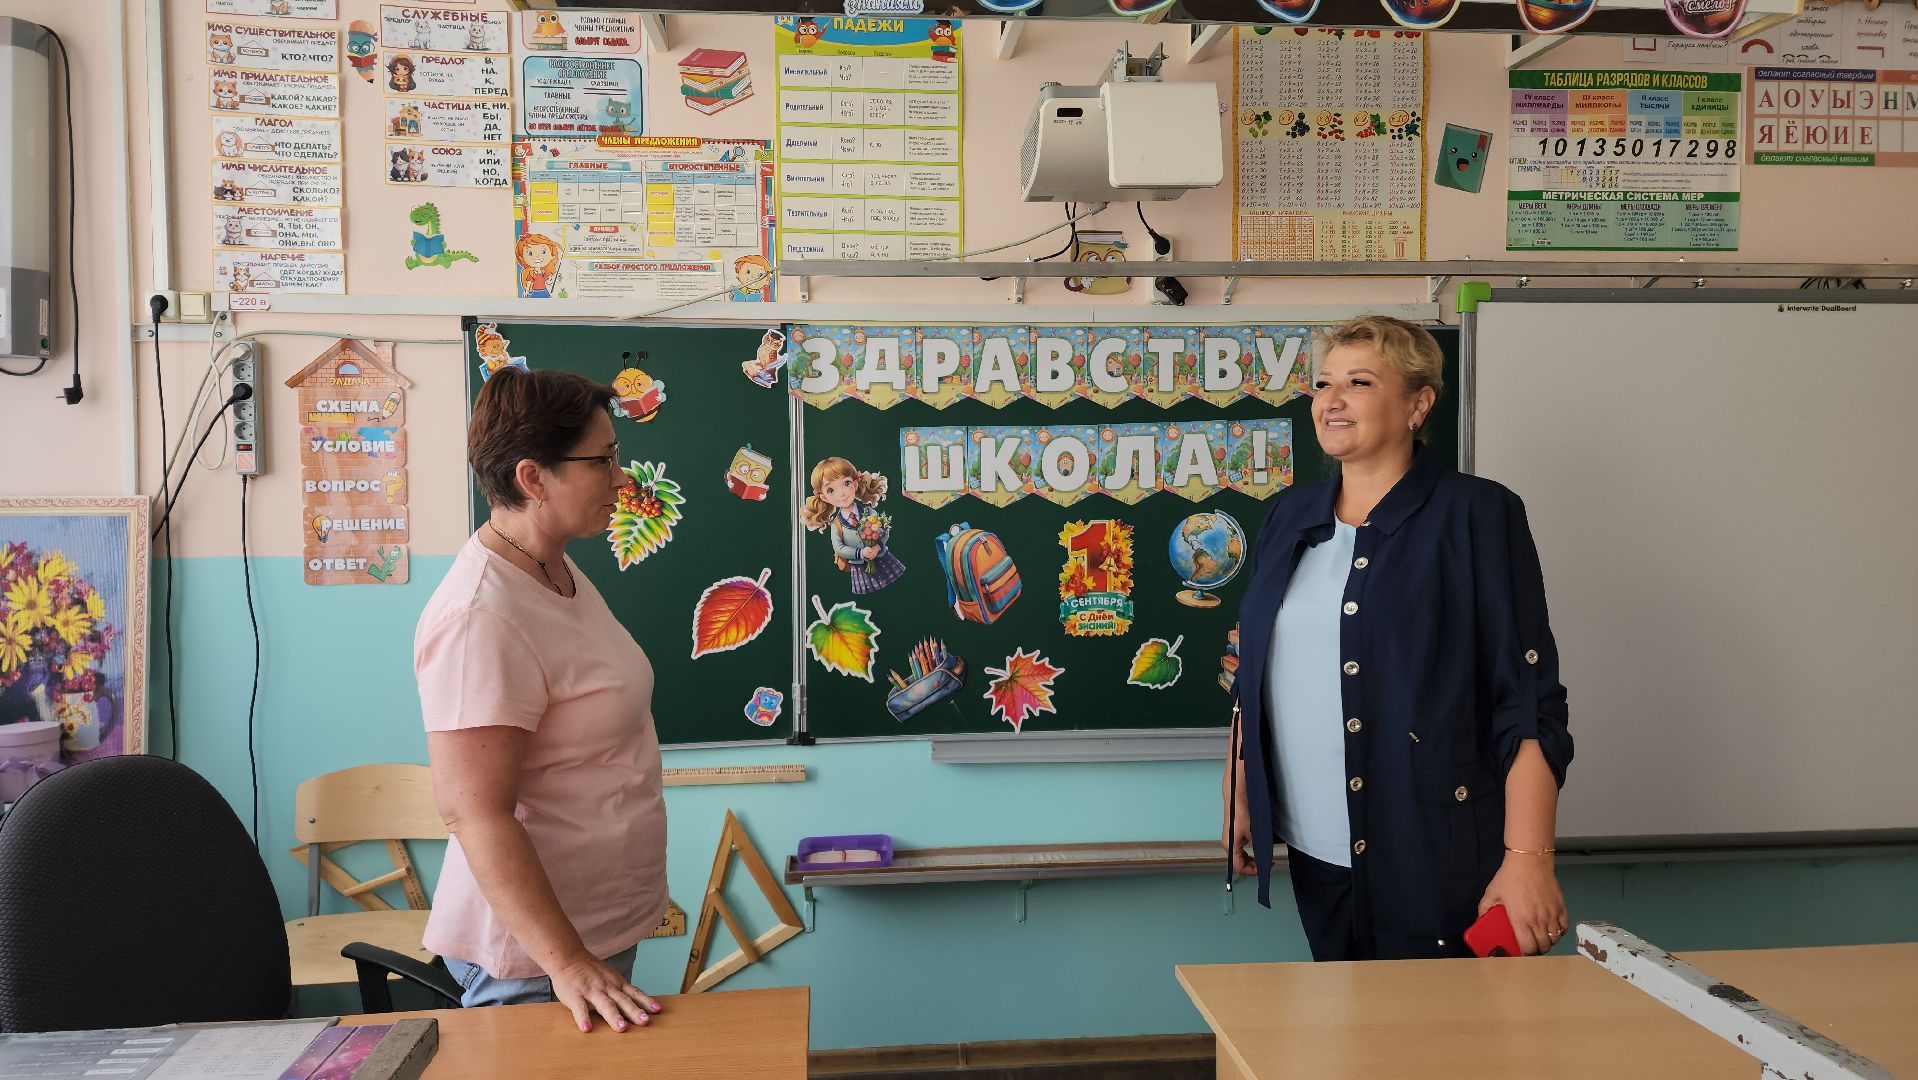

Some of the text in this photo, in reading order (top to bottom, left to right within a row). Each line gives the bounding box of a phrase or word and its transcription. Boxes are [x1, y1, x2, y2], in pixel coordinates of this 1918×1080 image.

[402, 9, 488, 22] СЛУЖЕБНЫЕ
[833, 17, 905, 33] ПАДЕЖИ
[207, 22, 336, 39] ИМЯ СУЩЕСТВИТЕЛЬНОЕ
[281, 53, 334, 62] КТО? ЧТО?
[421, 56, 468, 65] ПРЕДЛОГ
[213, 69, 329, 84] ИМЯ ПРИЛАГАТЕЛЬНОЕ
[1793, 70, 1835, 79] согласный
[1837, 72, 1875, 80] твердым
[1544, 72, 1708, 89] ТАБЛИЦА РАЗРЯДОВ И КЛАССОВ
[474, 87, 509, 96] ПЕРЕД
[271, 93, 337, 103] КАКОЙ? КАКАЯ?
[1758, 88, 1774, 108] А
[1784, 88, 1801, 108] О
[1810, 89, 1825, 108] У
[1831, 90, 1852, 109] Ы
[1859, 90, 1874, 110] Э
[1884, 91, 1898, 110] Н
[306, 104, 337, 112] КАКИЕ?
[424, 101, 472, 111] ЧАСТИЦА
[785, 102, 824, 111] Родительный
[1691, 104, 1729, 112] ЕДИНИЦЫ
[255, 117, 293, 127] ГЛАГОЛ
[483, 133, 502, 141] НЕТ
[1758, 124, 1774, 144] Я
[1785, 120, 1798, 144] Ё
[1805, 125, 1828, 145] Ю
[1832, 125, 1848, 145] И
[1860, 126, 1873, 145] Е
[274, 141, 292, 150] ЧТО
[293, 142, 332, 152] ДЕЛАТЬ?
[601, 136, 698, 147] ЧЛЕНЫ ПРЕДЛОЖЕНИЯ
[274, 150, 338, 159] ЧТО СДЕЛАТЬ?
[432, 147, 463, 156] СОЮЗ
[1761, 154, 1869, 163] делают согласный мягким
[221, 162, 328, 174] ИМЯ ЧИСЛИТЕЛЬНОЕ
[568, 161, 609, 170] ГЛАВНЫЕ
[668, 163, 741, 172] ВТОРОСТЕПЕННЫЕ
[475, 177, 509, 187] КОГДА
[292, 187, 340, 195] СКОЛЬКО?
[1542, 191, 1705, 201] МЕТРИЧЕСКАЯ СИСТЕМА МЕР
[292, 195, 329, 203] КАКОЙ?
[237, 207, 314, 216] МЕСТОИМЕНИЕ
[260, 253, 305, 261] НАРЕЧИЕ
[593, 263, 712, 271] РАЗБОР ПРОСТОГО ПРЕДЛОЖЕНИЯ
[1787, 304, 1857, 312] Interwrite DualBoard
[800, 336, 1316, 393] ЗДРАВСТВУ
[329, 377, 370, 387] ЗАДАЧА
[316, 399, 381, 413] СХЕМА
[311, 440, 396, 454] УСЛОВИЕ
[305, 479, 382, 493] ВОПРОС
[321, 518, 405, 531] РЕШЕНИЕ
[1069, 520, 1113, 593] 1
[308, 558, 367, 572] ОТВЕТ
[1070, 596, 1123, 609] СЕНТЯБРЯ
[1088, 612, 1114, 623] Днём
